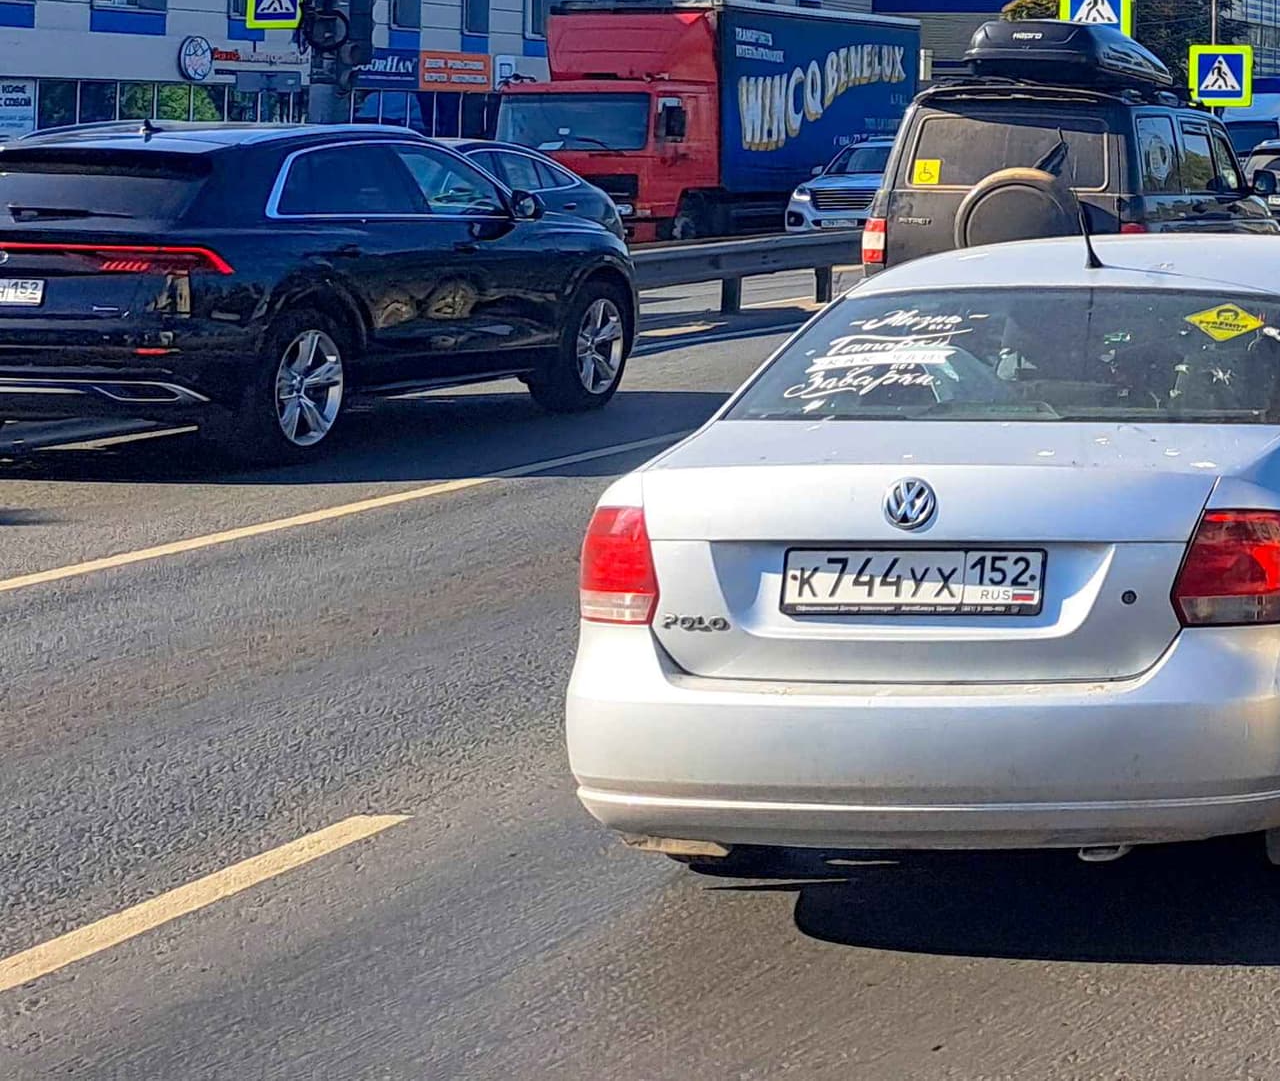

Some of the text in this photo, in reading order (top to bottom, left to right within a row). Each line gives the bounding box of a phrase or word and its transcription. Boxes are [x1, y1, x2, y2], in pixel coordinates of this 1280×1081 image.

[824, 44, 906, 109] BENELUX
[10, 280, 39, 296] 152
[799, 556, 1031, 598] К744УХ 152
[980, 589, 1011, 600] RUS
[663, 615, 731, 632] POLO
